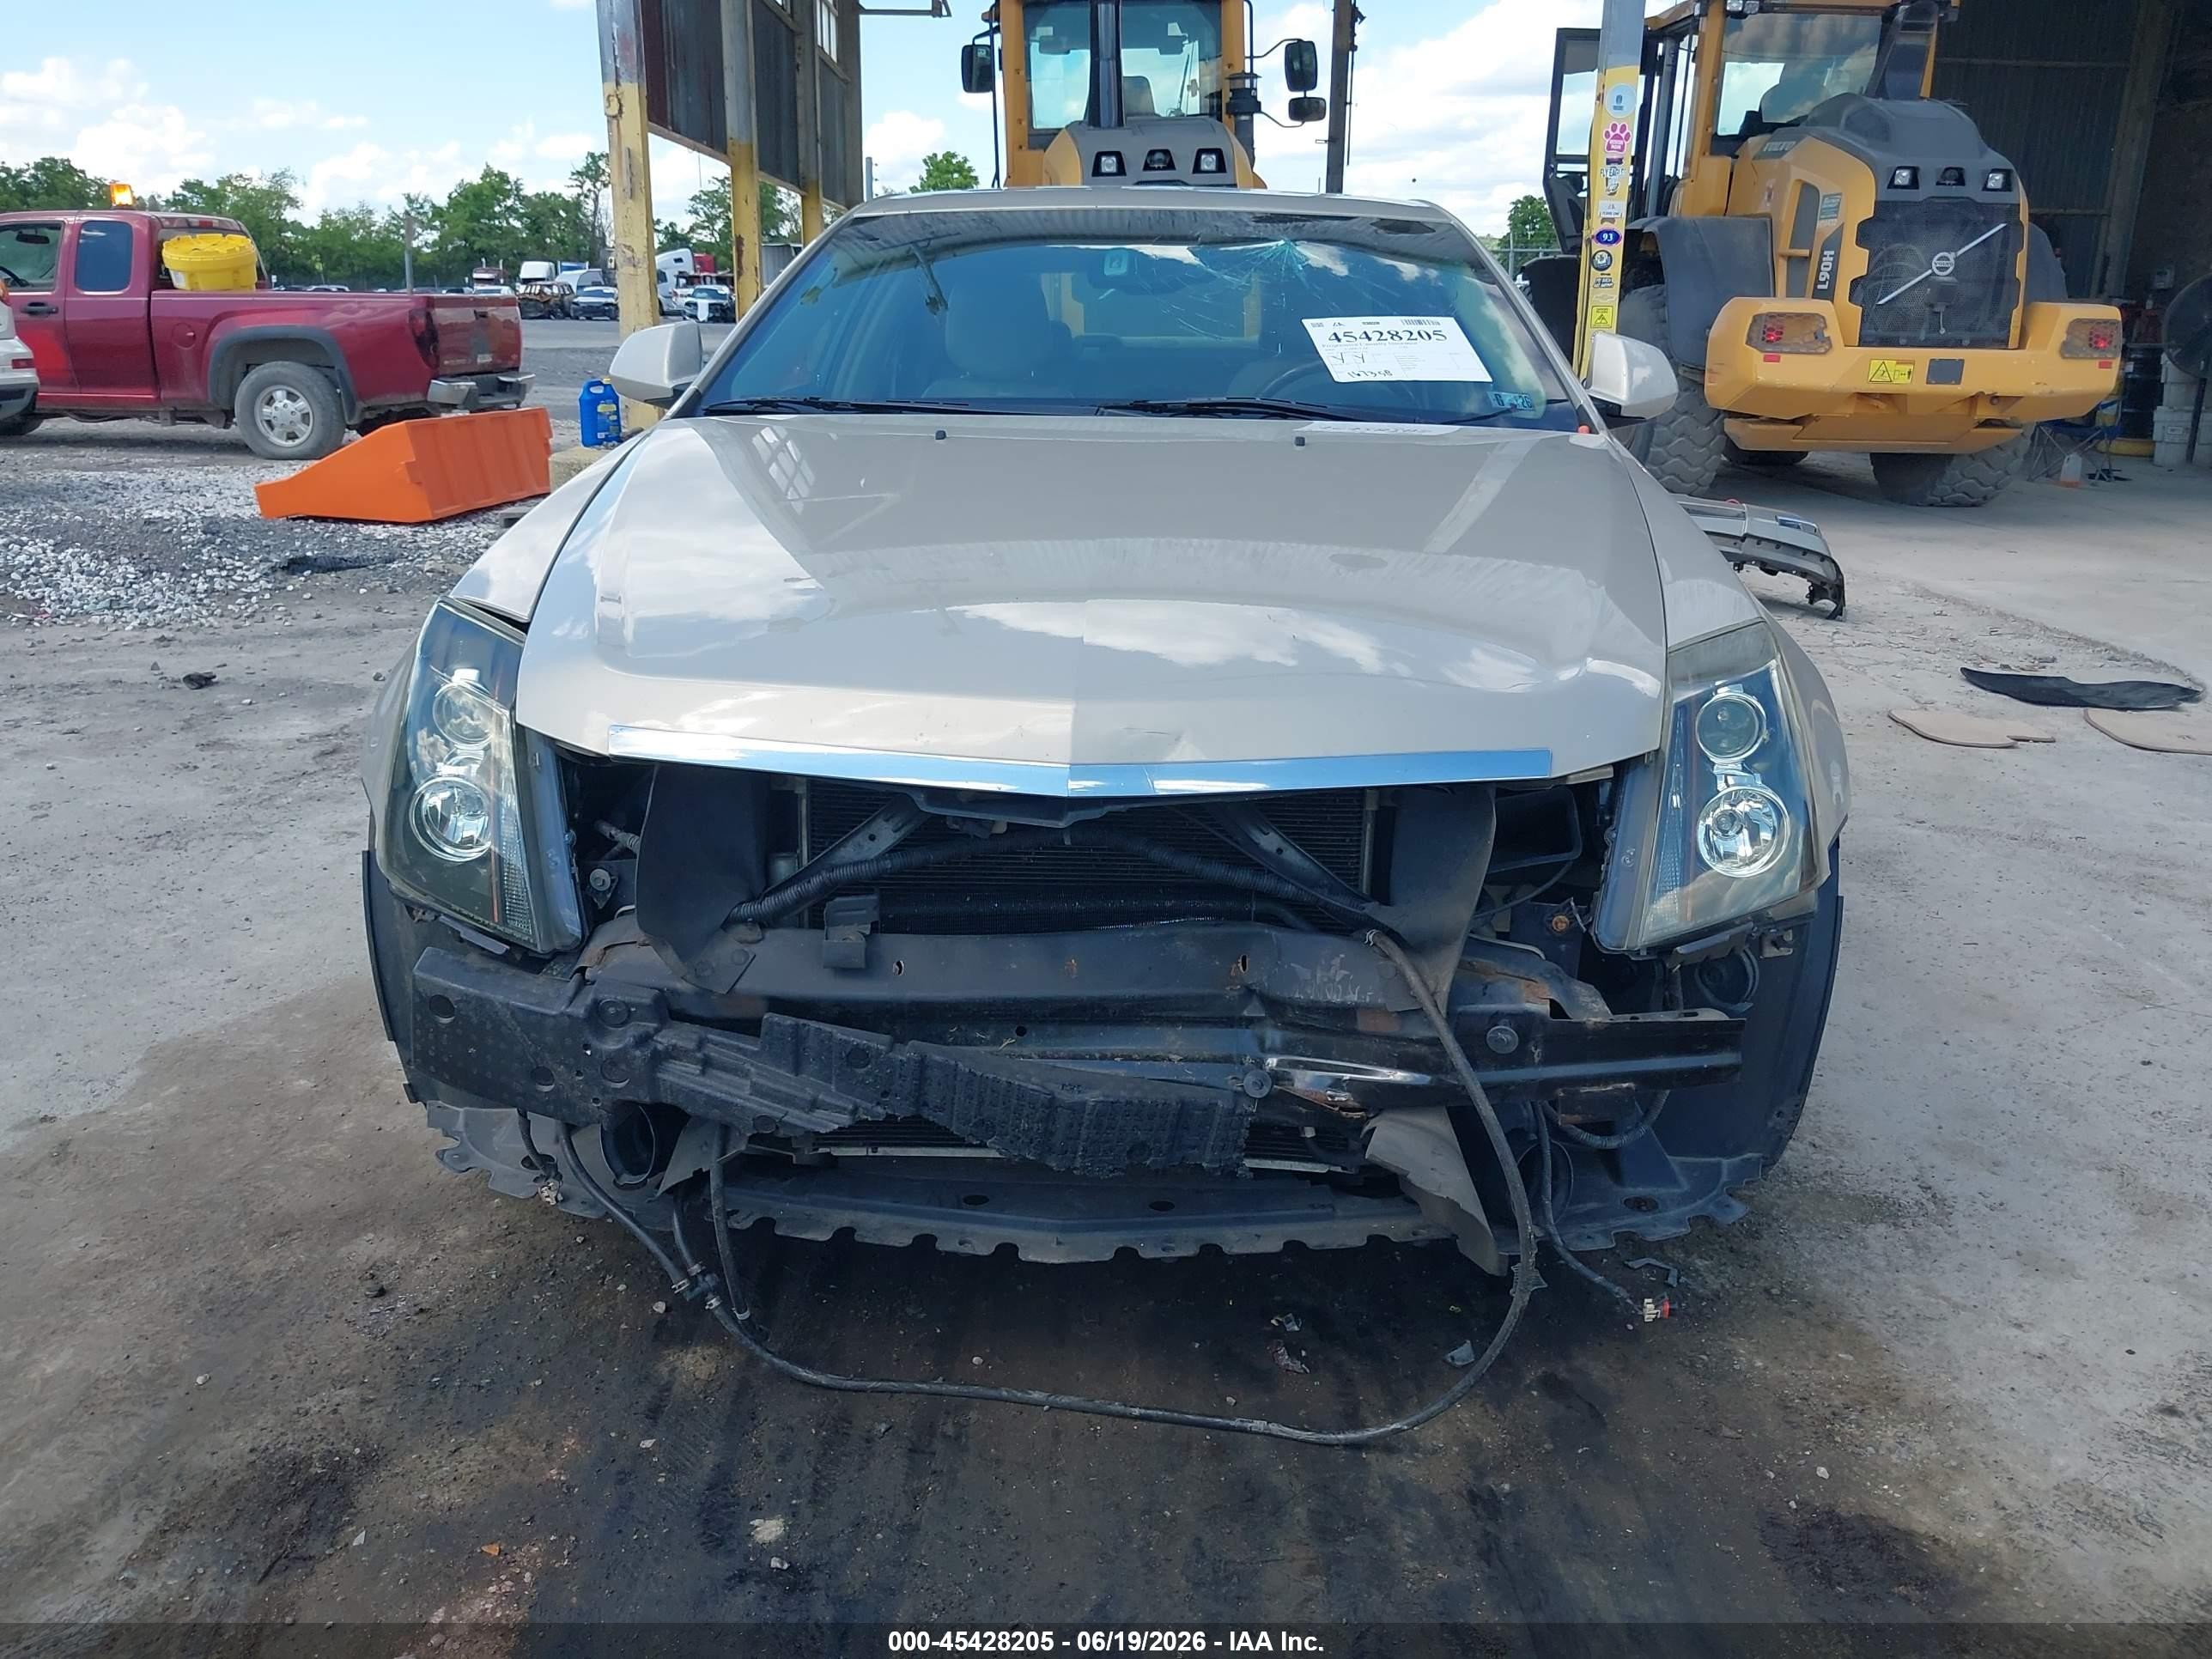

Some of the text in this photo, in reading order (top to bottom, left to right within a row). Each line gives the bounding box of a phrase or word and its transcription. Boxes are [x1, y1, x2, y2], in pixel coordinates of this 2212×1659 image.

[1602, 233, 1613, 241] 93
[1817, 250, 1835, 289] L90H
[1328, 329, 1448, 343] 45428205
